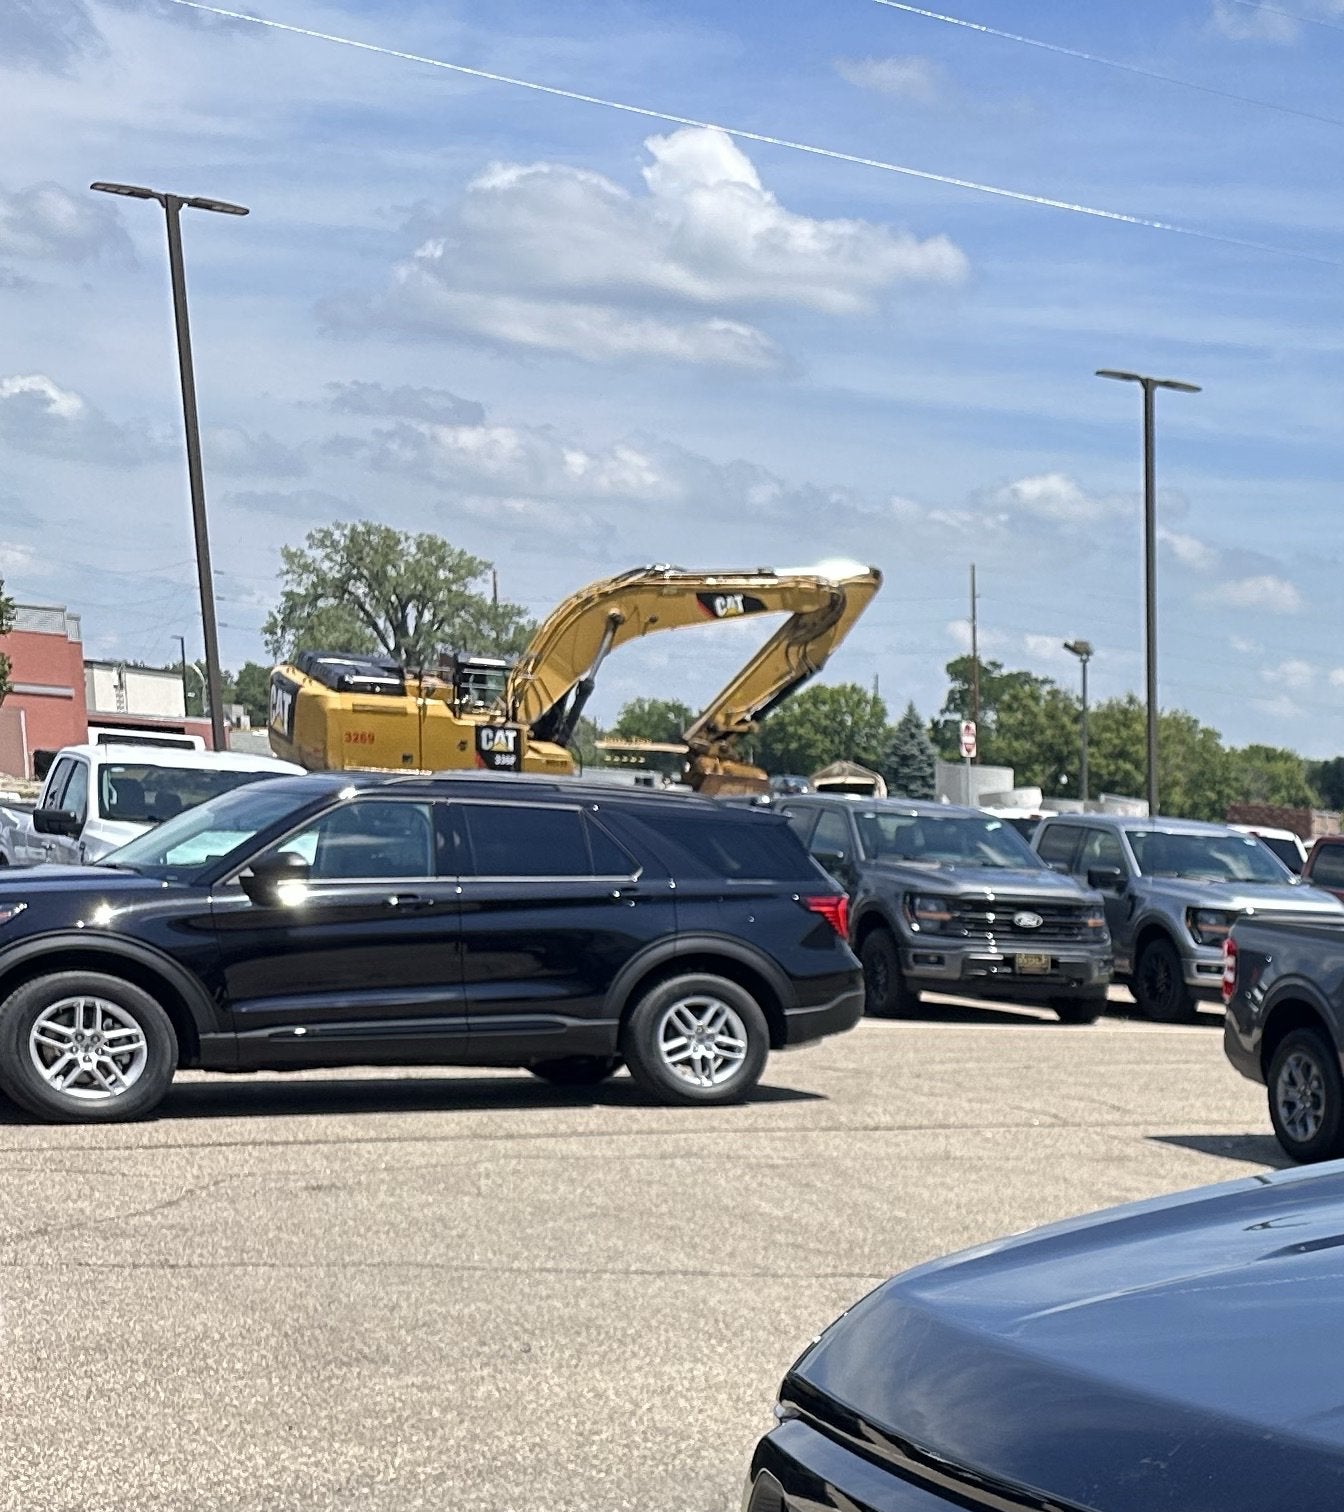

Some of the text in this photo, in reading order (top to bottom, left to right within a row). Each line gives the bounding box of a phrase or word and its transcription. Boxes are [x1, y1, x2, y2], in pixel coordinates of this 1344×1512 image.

[714, 593, 745, 618] CAT
[270, 683, 293, 736] CAT
[480, 726, 518, 752] CAT
